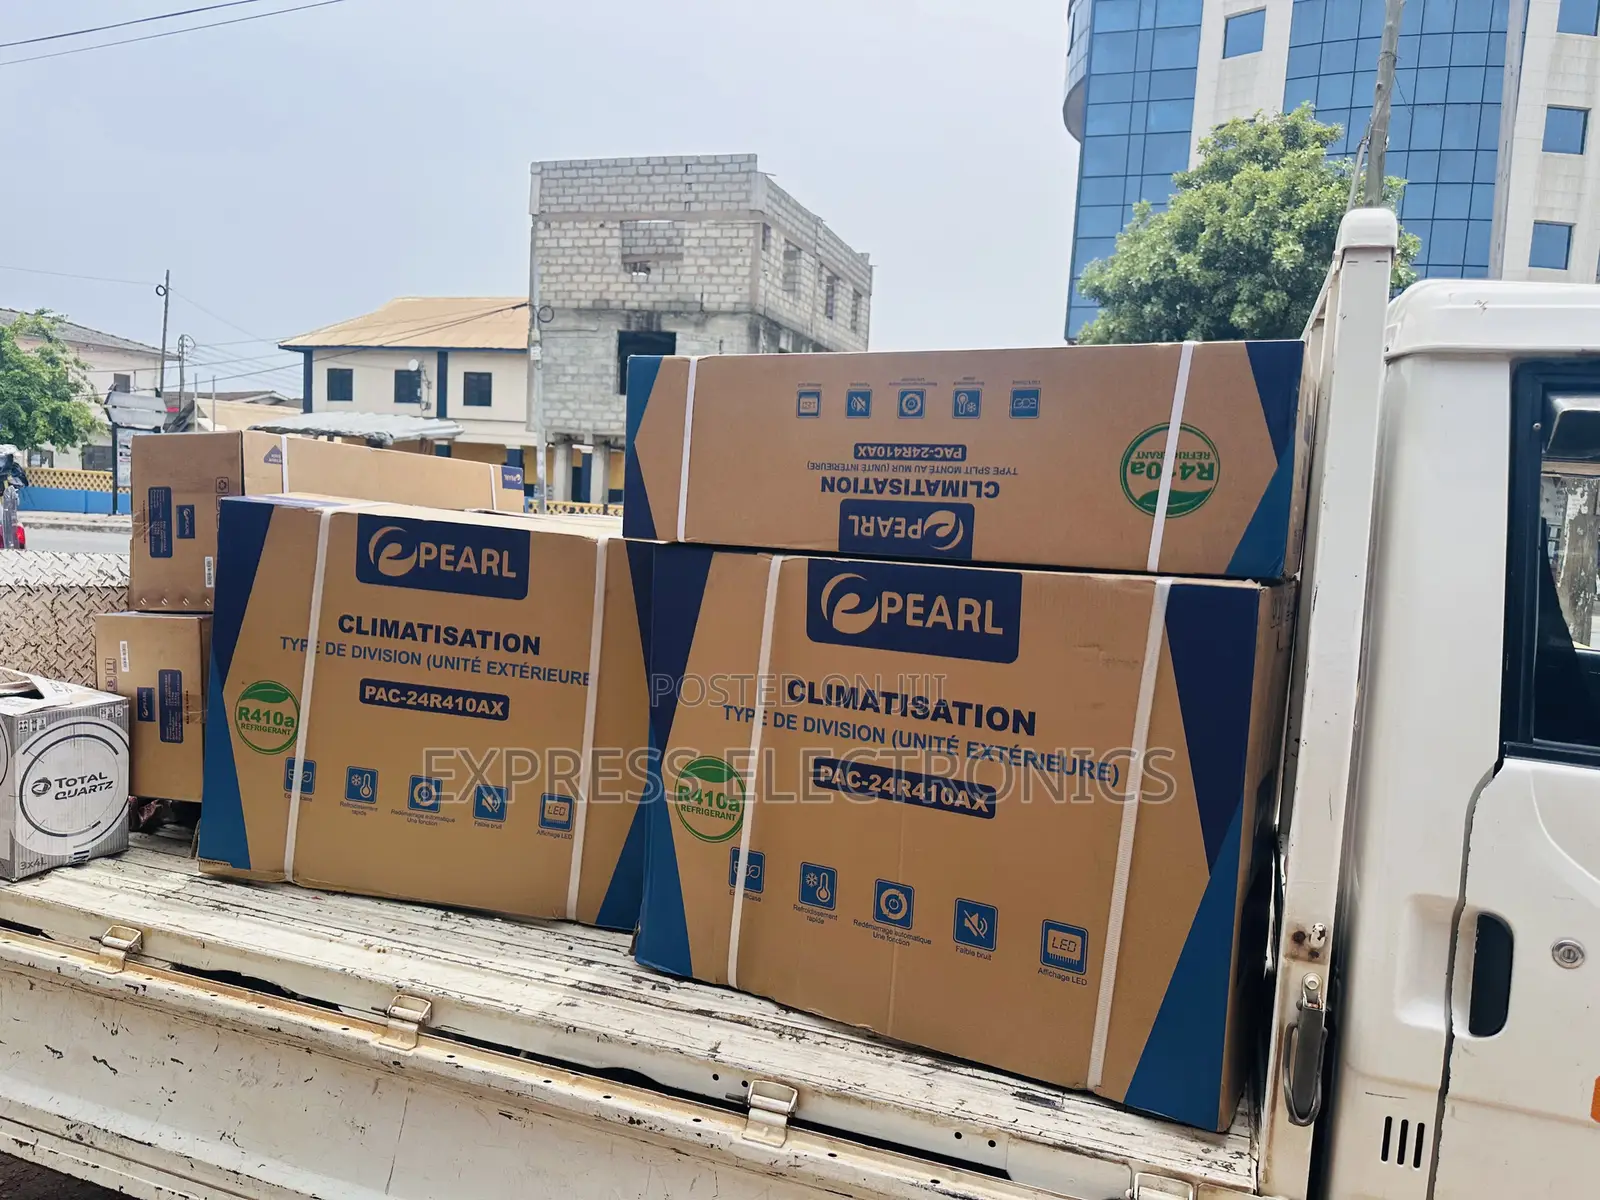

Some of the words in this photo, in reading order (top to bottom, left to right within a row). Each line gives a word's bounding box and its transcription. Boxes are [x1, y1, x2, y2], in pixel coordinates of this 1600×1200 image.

[858, 445, 962, 459] PAC-24R410AX
[1136, 451, 1211, 460] REFRIRANT
[861, 463, 890, 473] (UNITÉ
[891, 464, 912, 473] MUR
[914, 465, 927, 474] AU
[929, 465, 961, 475] MONTÉ
[963, 466, 991, 475] SPLIT
[992, 466, 1019, 476] TYPE
[1130, 461, 1215, 480] R40a
[820, 476, 1000, 499] CLIMATISATION
[848, 515, 924, 539] PEARL
[419, 541, 517, 578] PEARL
[880, 590, 1003, 635] PEARL
[338, 614, 540, 656] CLIMATISATION
[325, 641, 347, 657] DE
[351, 645, 422, 666] DIVISION
[426, 654, 481, 673] (UNITÉ
[364, 685, 504, 716] PAC-24R410AX
[787, 679, 1036, 737] CLIMATISATION
[238, 706, 295, 728] R410a
[240, 722, 292, 736] REFRIGERANT
[773, 711, 798, 731] DE
[803, 716, 885, 745] DIVISION
[891, 729, 960, 757] (UNITÉ
[966, 741, 1120, 788] EXTÉRIEURE)
[54, 772, 108, 789] TOTAL
[54, 780, 114, 800] QUARTZ
[819, 765, 990, 814] PAC-24R410AX
[677, 785, 740, 812] R410a
[680, 804, 737, 821] REFRIGERANT
[418, 818, 438, 827] fonction
[560, 832, 573, 840] LED
[793, 904, 838, 922] Refroidissement
[806, 914, 825, 925] rapide
[853, 919, 893, 936] Redémarrage
[893, 929, 932, 945] automatique
[872, 931, 886, 941] Une
[886, 934, 910, 947] fonction
[955, 945, 976, 957] Faible
[976, 949, 992, 961] bruit
[1051, 936, 1077, 953] LED
[1037, 967, 1071, 983] Affichage
[1071, 976, 1088, 987] LED
